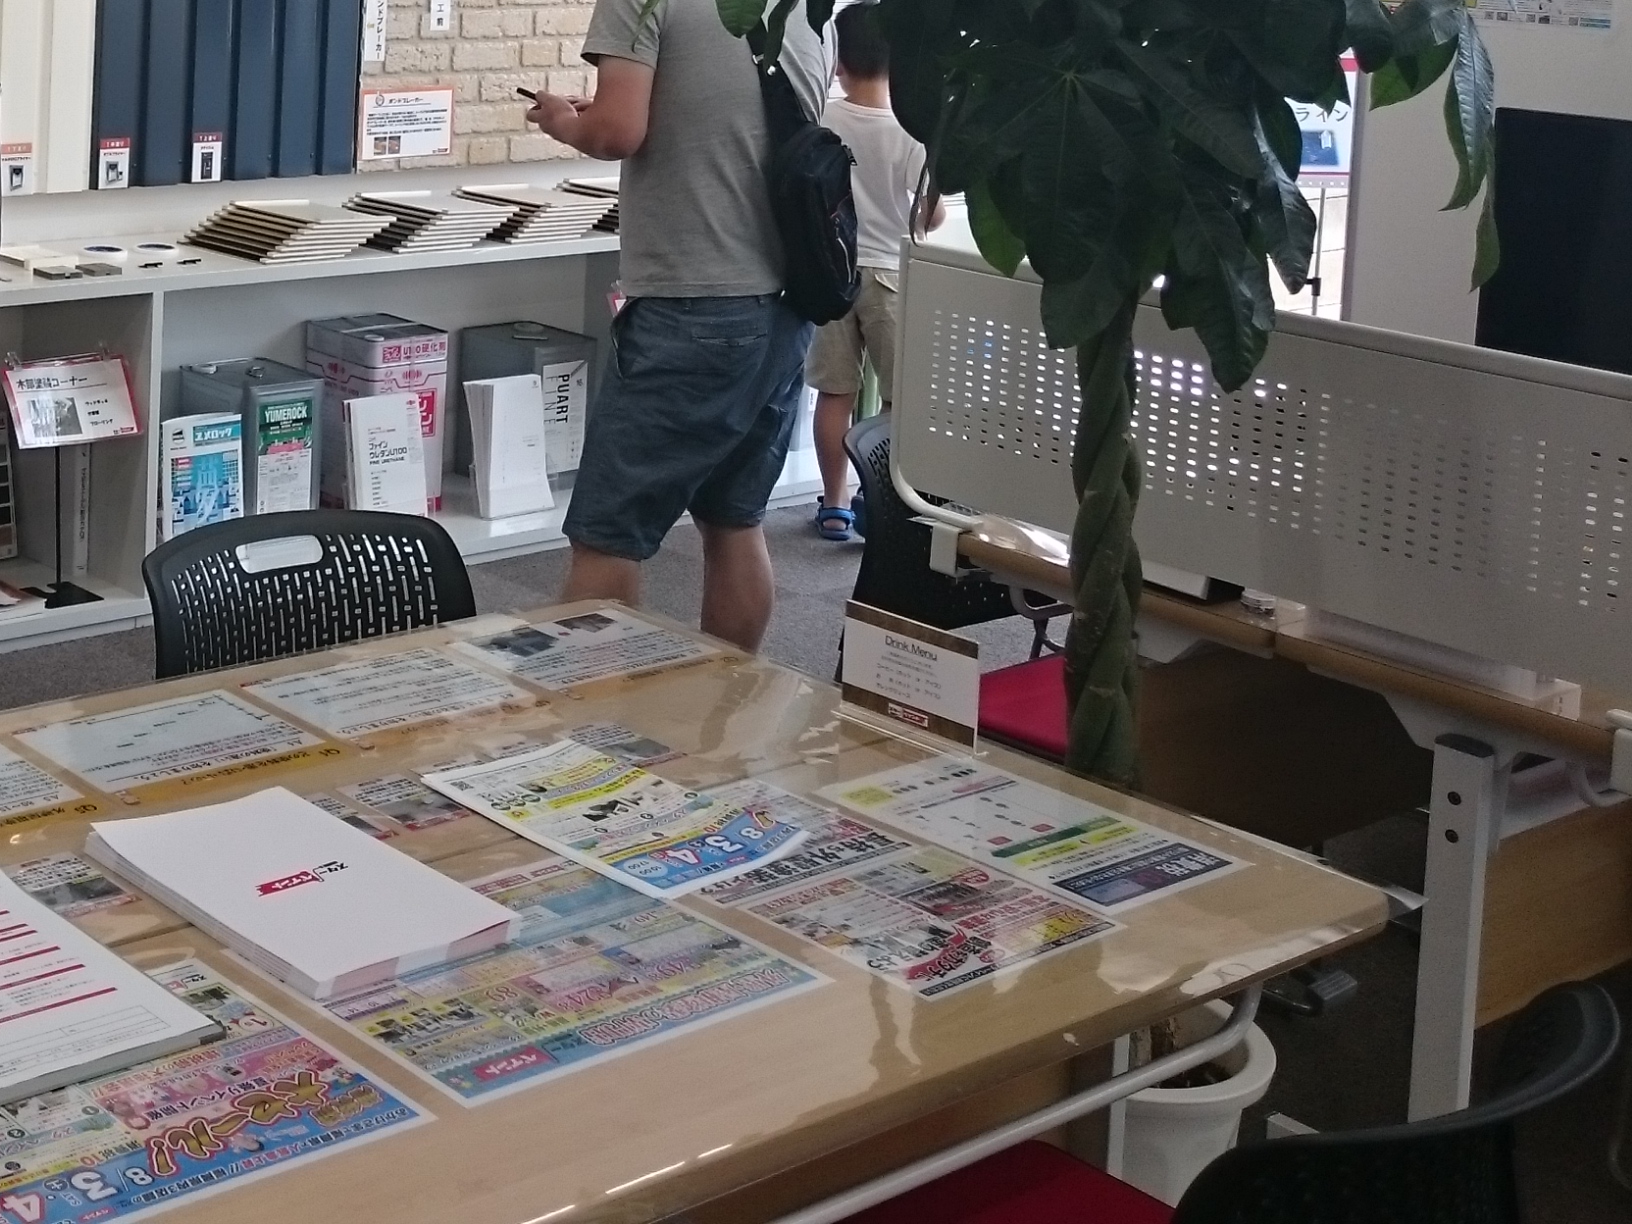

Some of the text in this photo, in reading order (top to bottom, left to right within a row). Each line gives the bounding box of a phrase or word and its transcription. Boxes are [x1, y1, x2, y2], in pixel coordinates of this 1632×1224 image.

[403, 341, 446, 356] U10硬化剤
[555, 373, 570, 424] PUART
[265, 405, 307, 423] YUMEROCK
[885, 634, 938, 662] Drink Menu
[272, 863, 349, 889] スター ペイント
[484, 986, 518, 1003] 89
[483, 1053, 538, 1077] ペイント
[1, 1190, 44, 1224] 4
